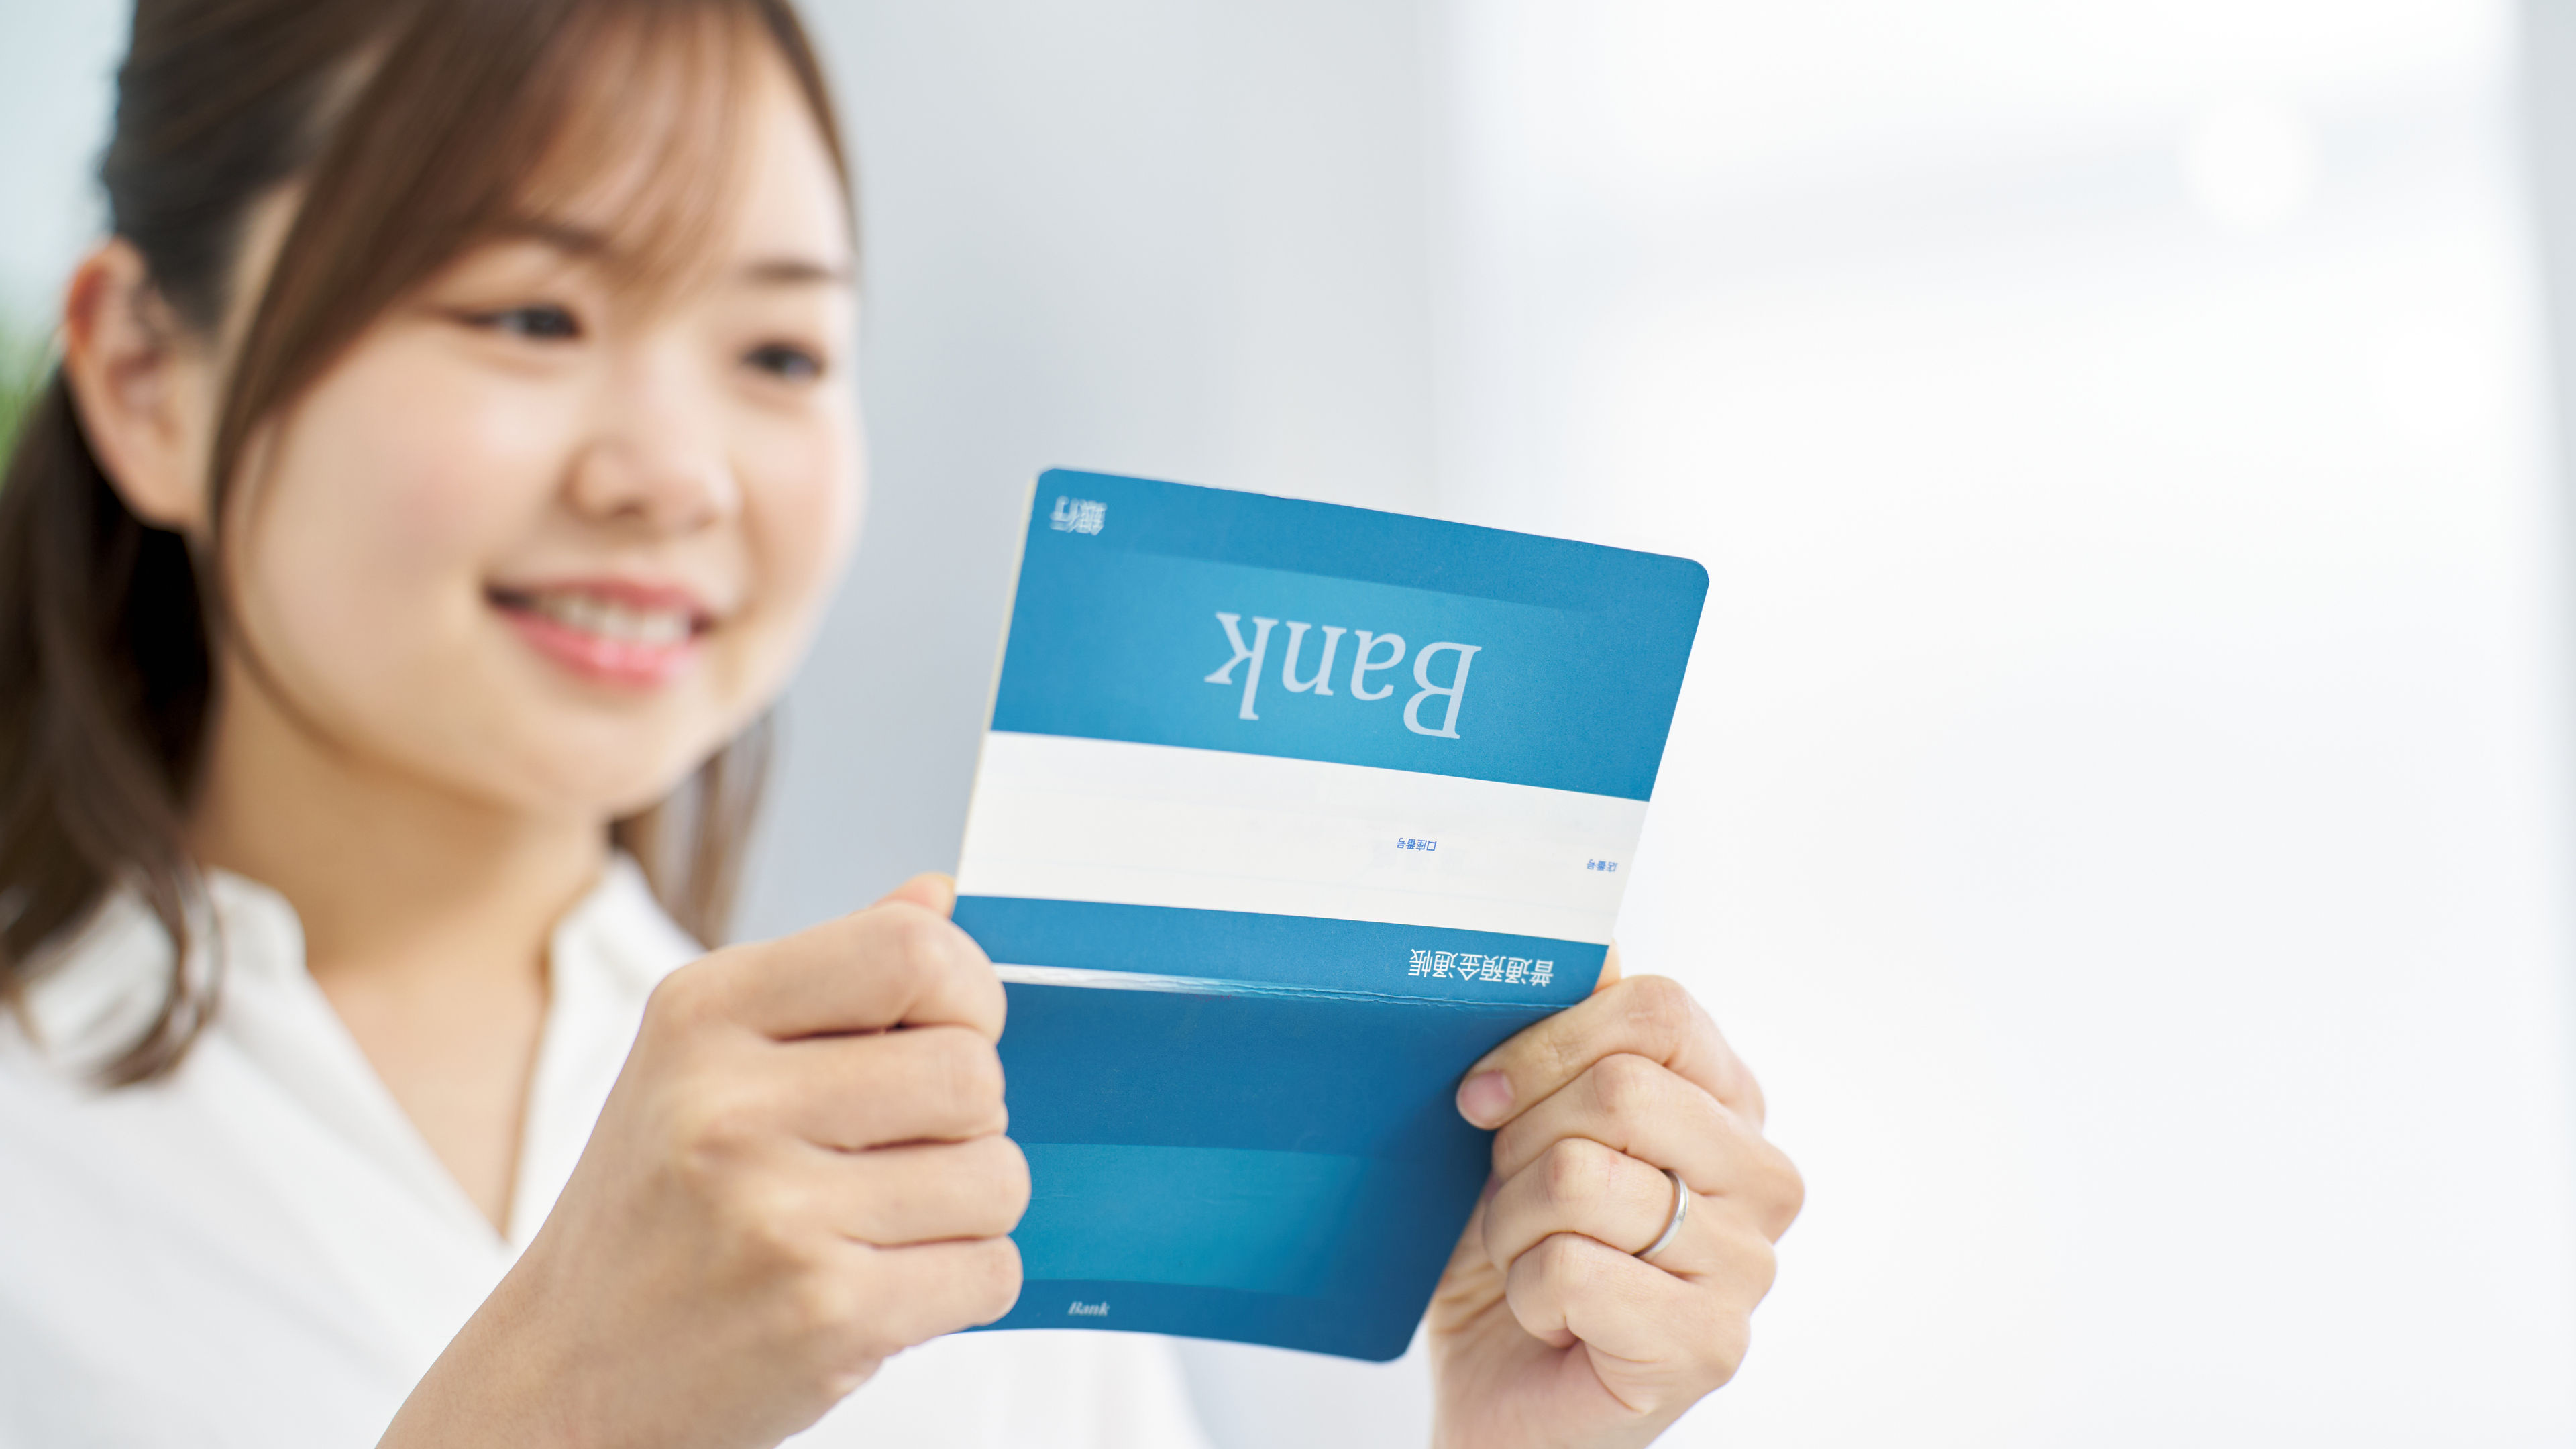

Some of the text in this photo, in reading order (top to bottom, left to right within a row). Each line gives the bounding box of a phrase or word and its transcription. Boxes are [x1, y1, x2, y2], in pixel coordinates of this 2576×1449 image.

[1049, 496, 1107, 535] 銀行
[1204, 612, 1482, 739] Bank
[1396, 837, 1437, 851] 口座番号
[1587, 859, 1618, 873] 店番号
[1408, 948, 1554, 987] 普通預金通帳
[1067, 1301, 1110, 1316] Bank
